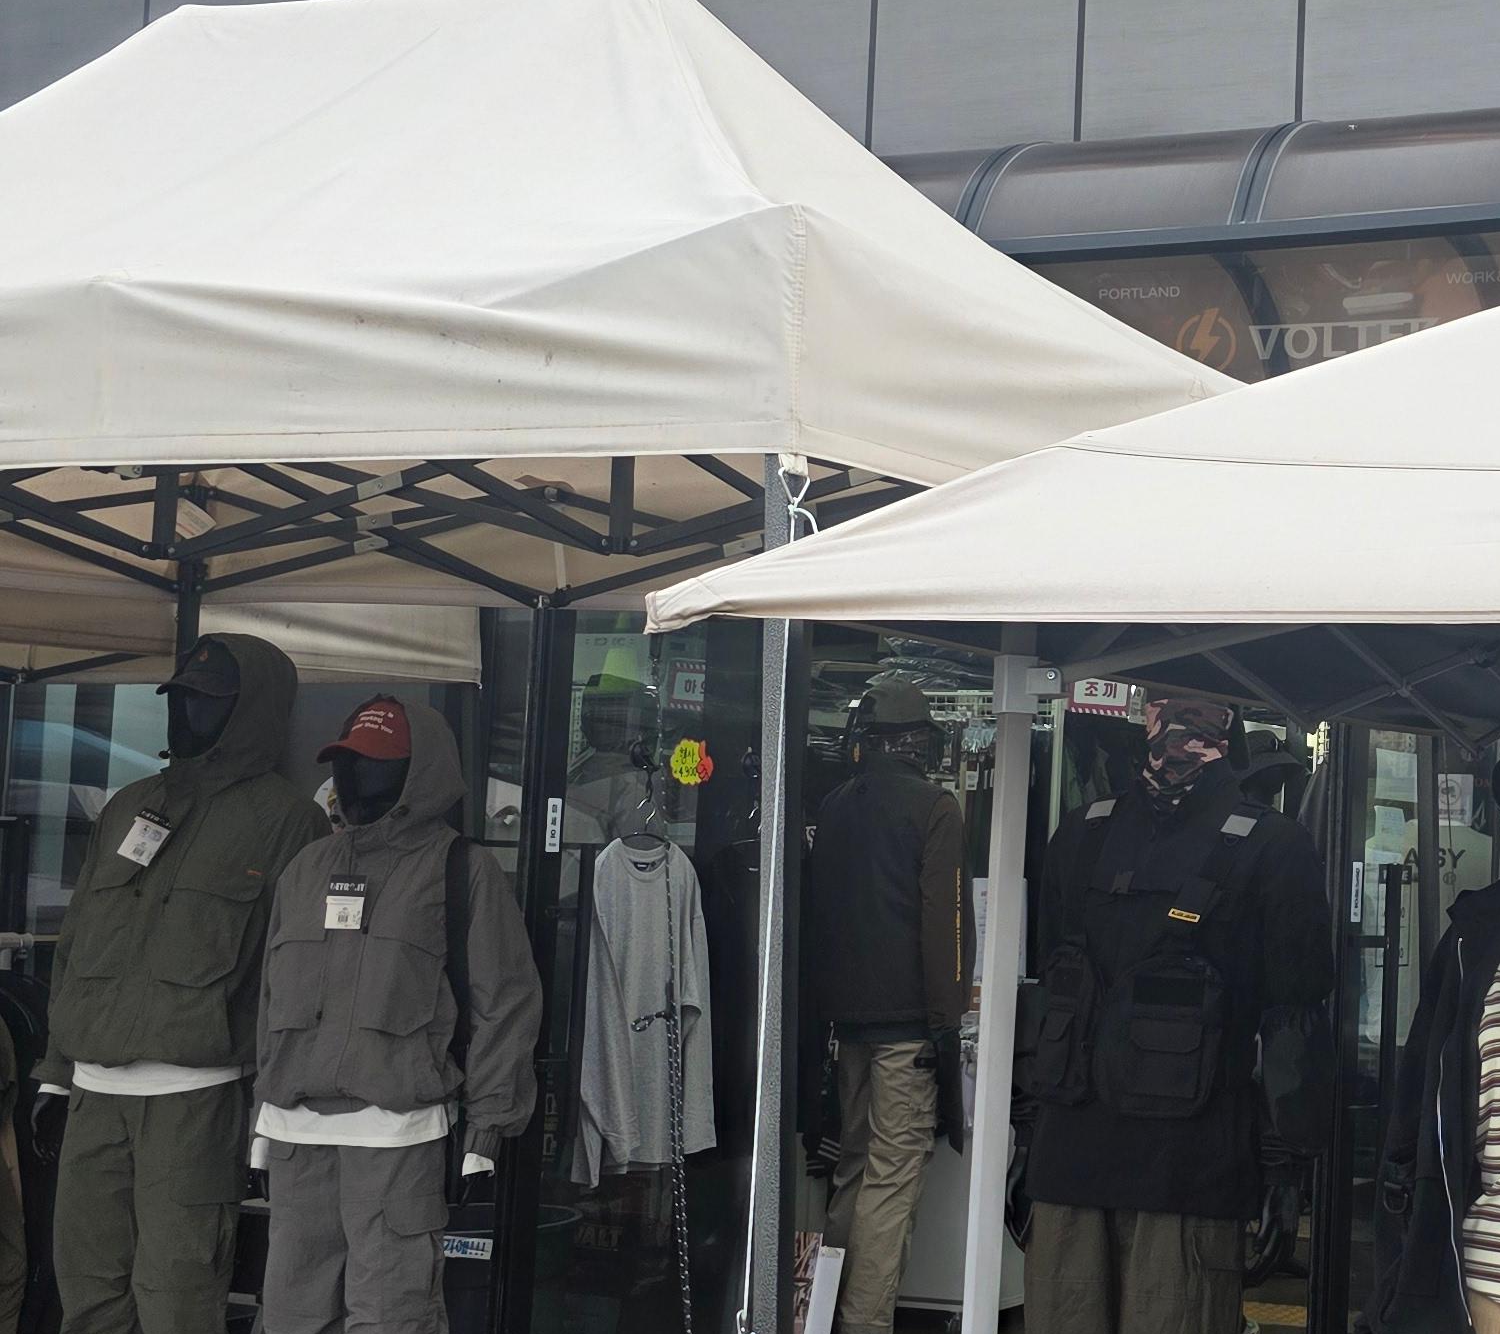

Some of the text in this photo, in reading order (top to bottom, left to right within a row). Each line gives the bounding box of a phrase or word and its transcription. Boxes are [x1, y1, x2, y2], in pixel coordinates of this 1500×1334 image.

[1099, 286, 1181, 299] PORTLAND
[1248, 318, 1440, 360] VOLTE
[1084, 681, 1118, 699] 조끼
